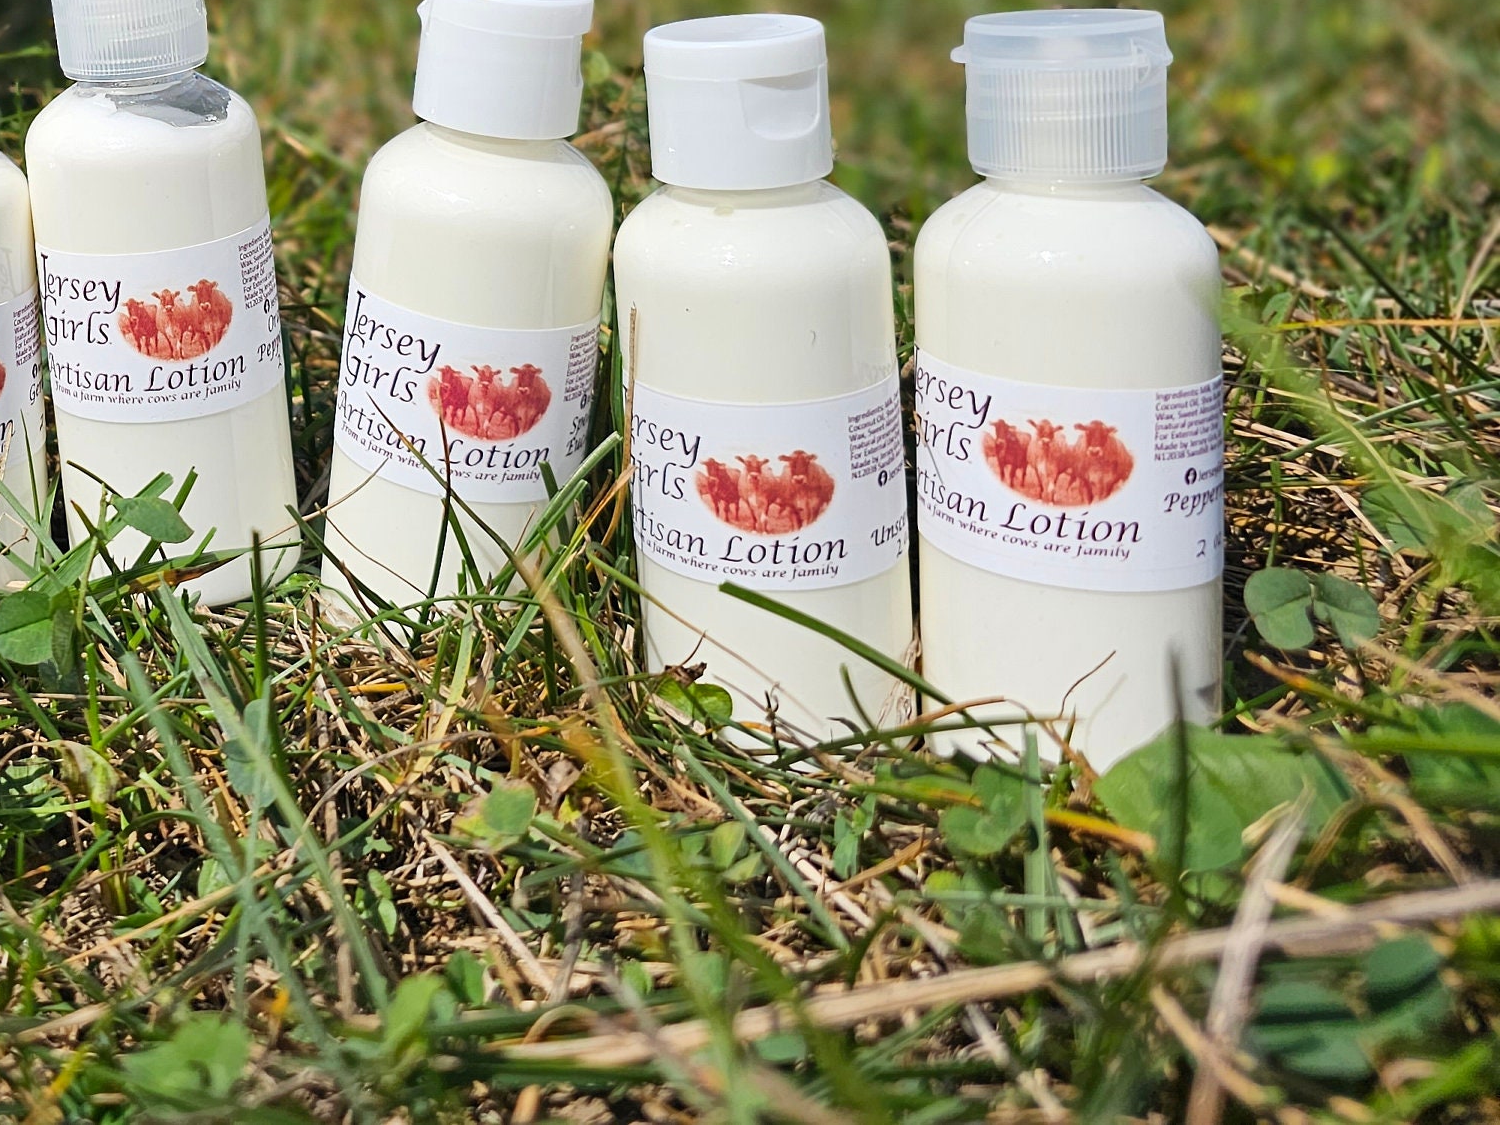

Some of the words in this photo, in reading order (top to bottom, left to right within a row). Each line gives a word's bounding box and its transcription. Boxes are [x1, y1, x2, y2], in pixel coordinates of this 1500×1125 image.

[40, 252, 122, 315] Jersey
[43, 295, 111, 346] Girls
[347, 290, 441, 374] Jersey
[48, 352, 134, 392] Artisan
[144, 355, 247, 392] Lotion
[108, 392, 144, 405] where
[147, 393, 177, 404] cows
[180, 390, 201, 400] are
[203, 376, 241, 400] family
[345, 333, 418, 404] Girls
[338, 390, 428, 457] Artisan
[438, 438, 550, 468] Lotion
[631, 414, 701, 469] rsey
[397, 454, 434, 472] whe
[475, 471, 498, 481] are
[497, 467, 541, 484] family
[916, 466, 989, 523] rtisan
[999, 502, 1143, 543] Lotion
[1164, 482, 1224, 518] Pepper
[633, 502, 708, 557] rtisan
[718, 535, 848, 565] Lotion
[958, 520, 998, 539] where
[1001, 533, 1038, 549] cows
[1043, 542, 1072, 554] are
[1071, 541, 1131, 562] family
[1196, 539, 1207, 558] 2
[680, 555, 719, 572] where
[722, 565, 756, 577] cows
[762, 568, 787, 578] are
[788, 561, 839, 582] family
